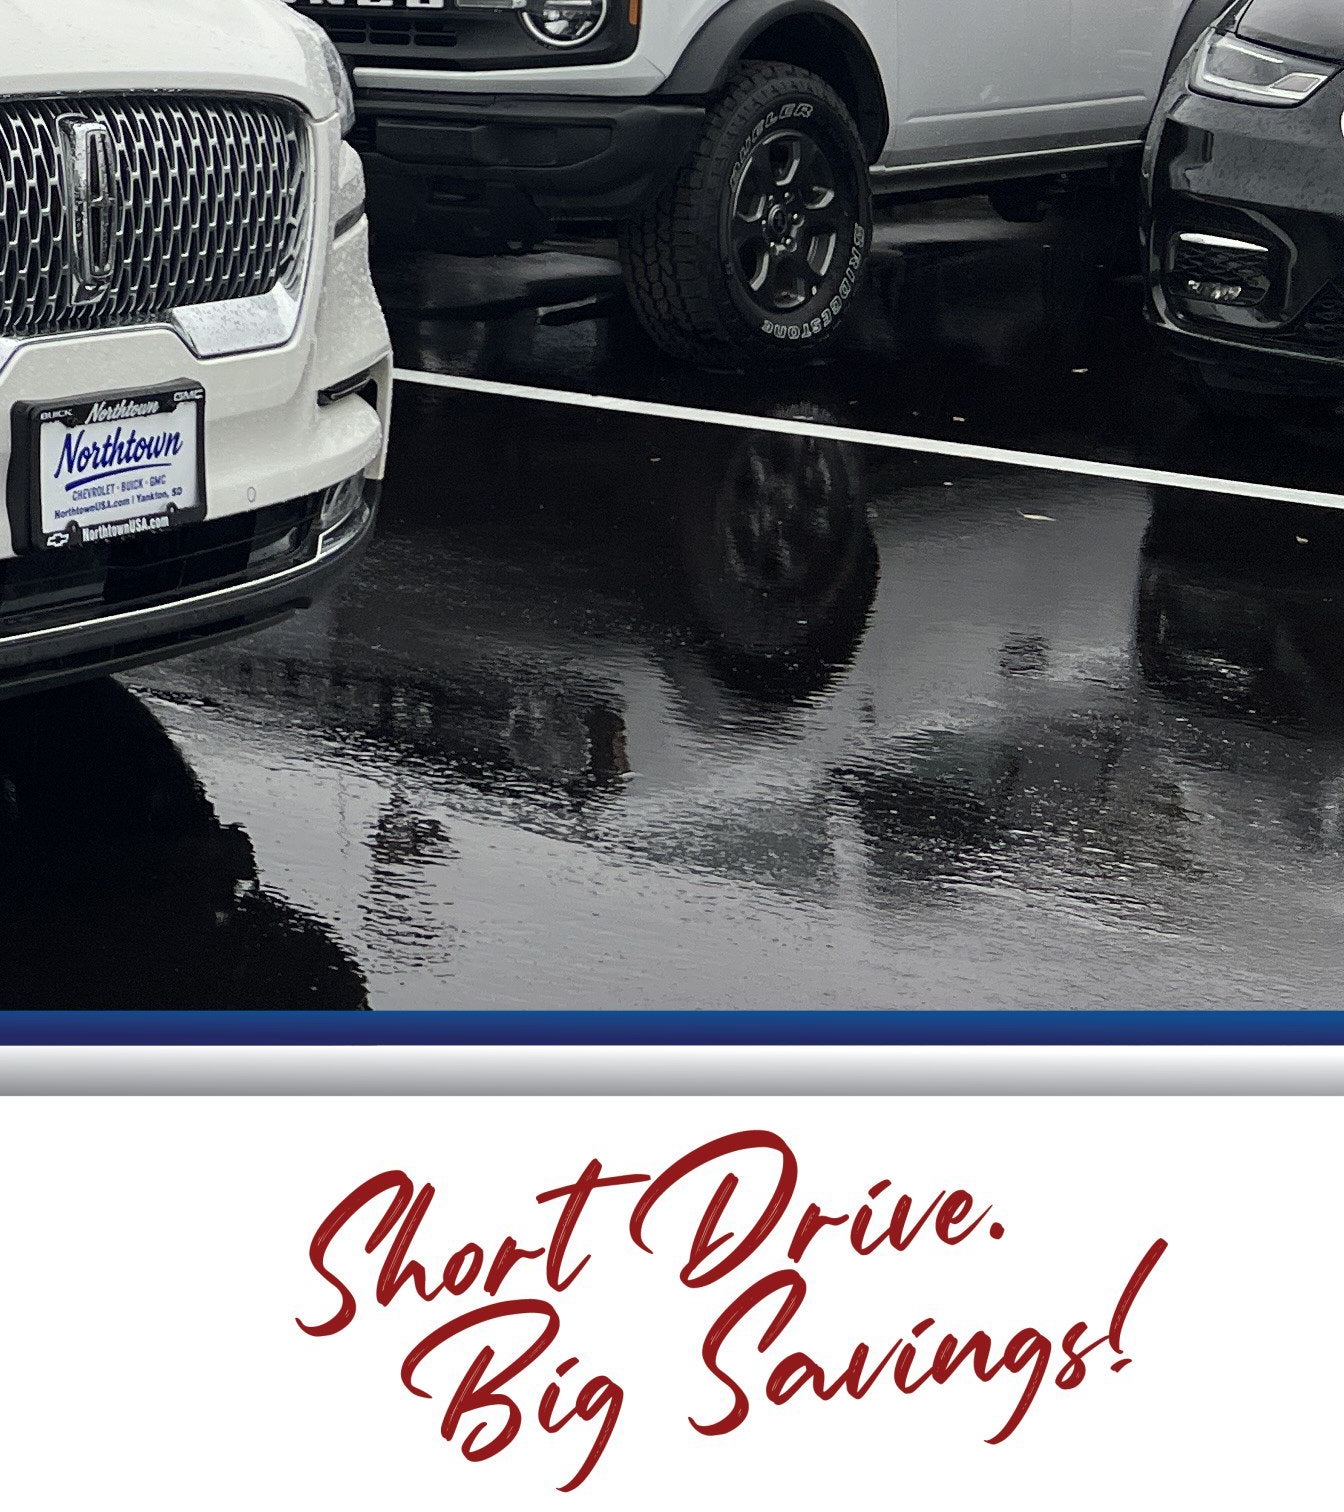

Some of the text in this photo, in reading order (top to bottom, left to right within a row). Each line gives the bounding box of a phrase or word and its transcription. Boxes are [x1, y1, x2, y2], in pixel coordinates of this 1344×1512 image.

[761, 222, 865, 340] BRIDGESTONE
[173, 389, 204, 402] GMC
[40, 408, 74, 421] BUICK
[85, 399, 160, 425] Northtown
[53, 426, 184, 479] Northtown
[72, 474, 167, 502] CHEVROLET BUICK GMC
[54, 497, 130, 519] NorthtownUSA.com
[172, 486, 183, 496] SD
[82, 515, 170, 542] NorthtownUSA.com
